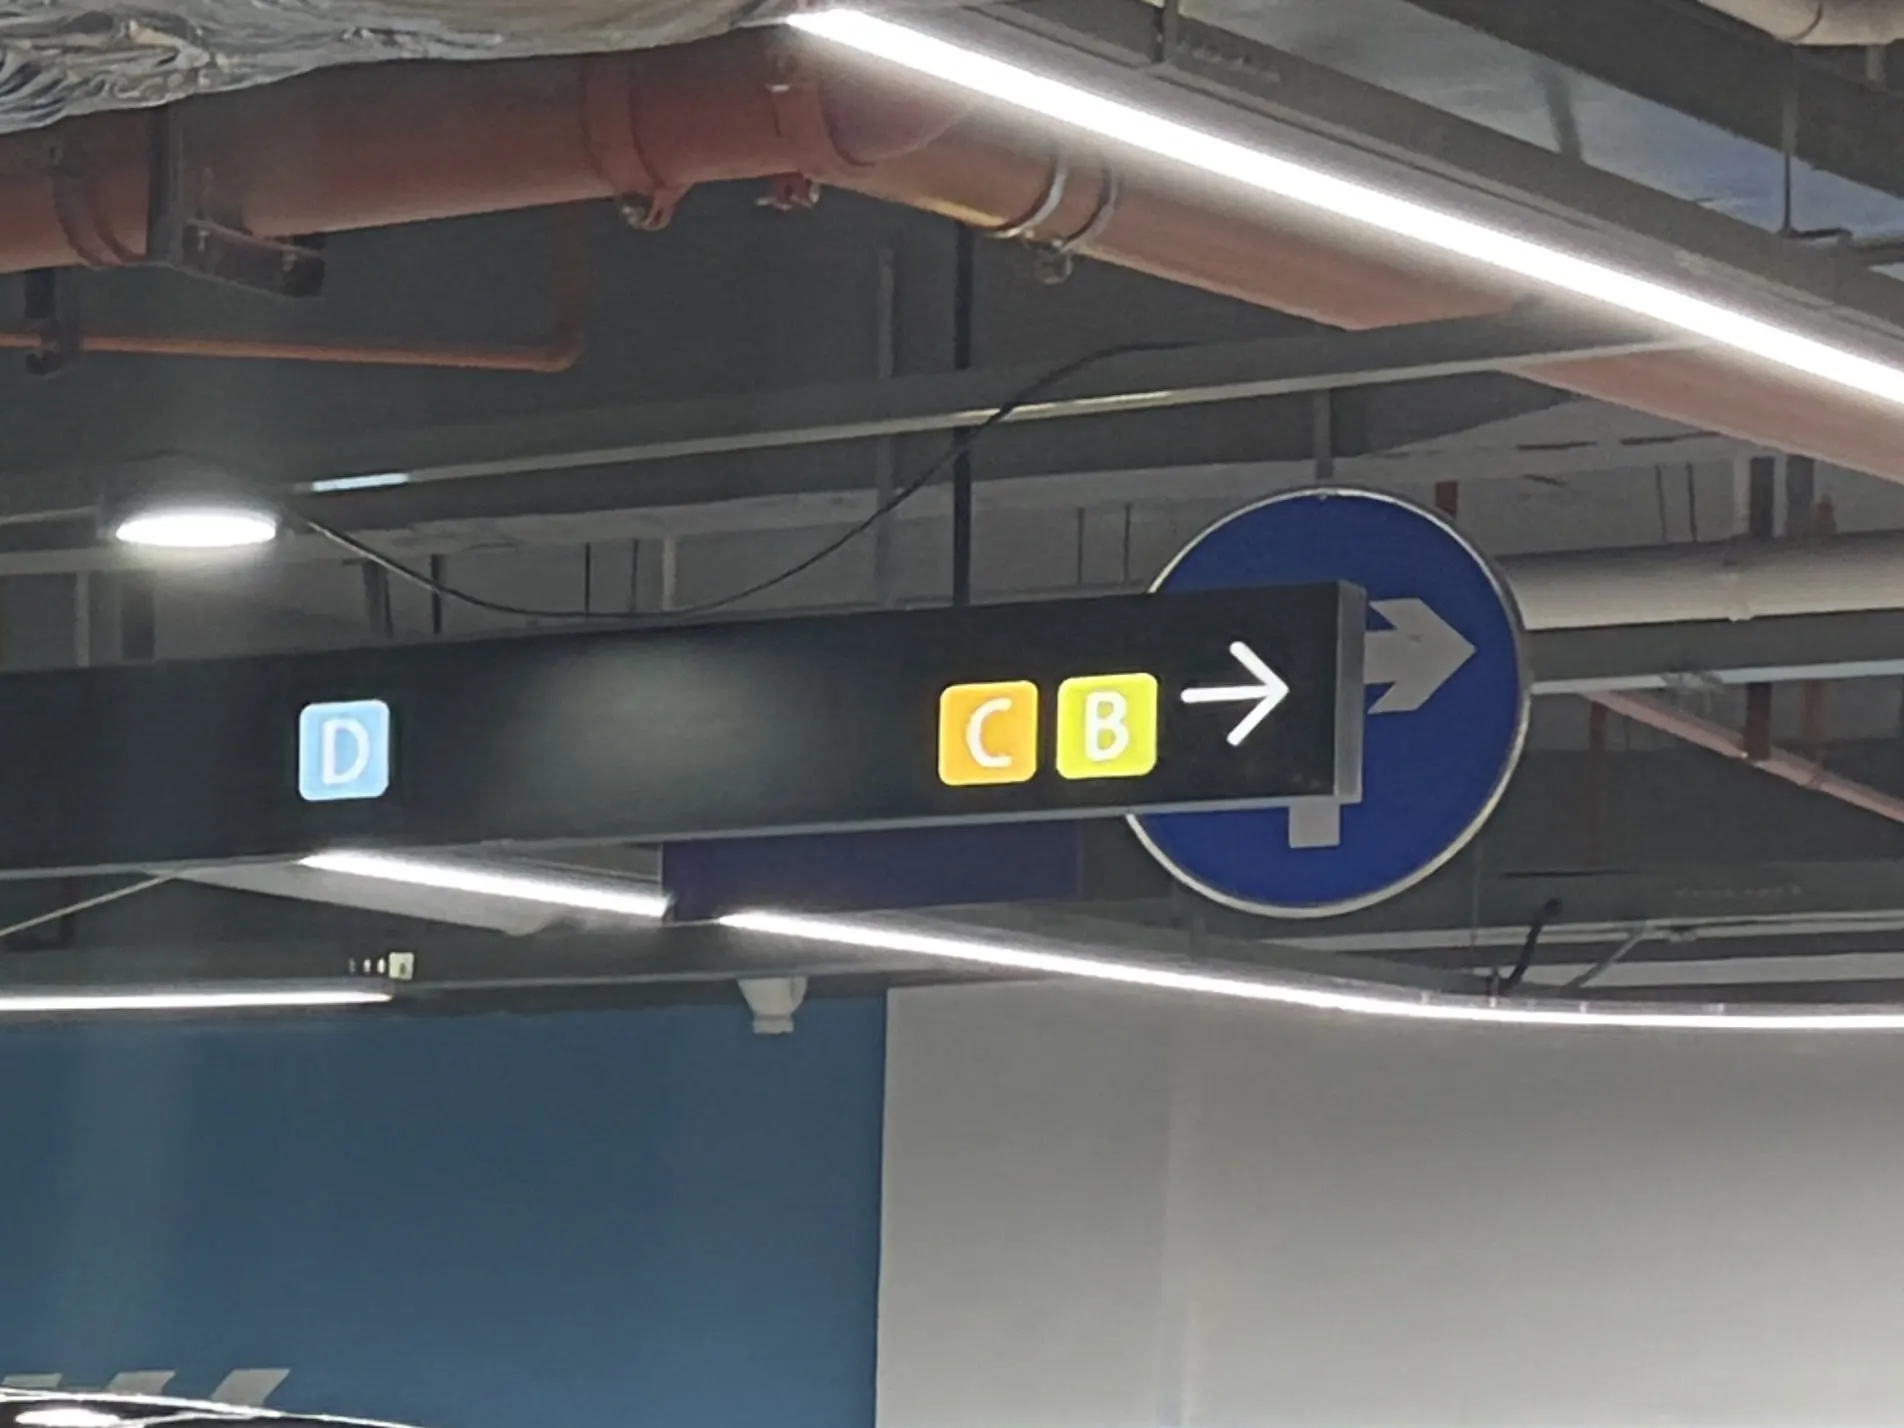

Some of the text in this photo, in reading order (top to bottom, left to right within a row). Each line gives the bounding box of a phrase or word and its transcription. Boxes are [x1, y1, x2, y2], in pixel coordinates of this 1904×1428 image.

[322, 717, 370, 786] D
[966, 690, 1130, 768] C B
